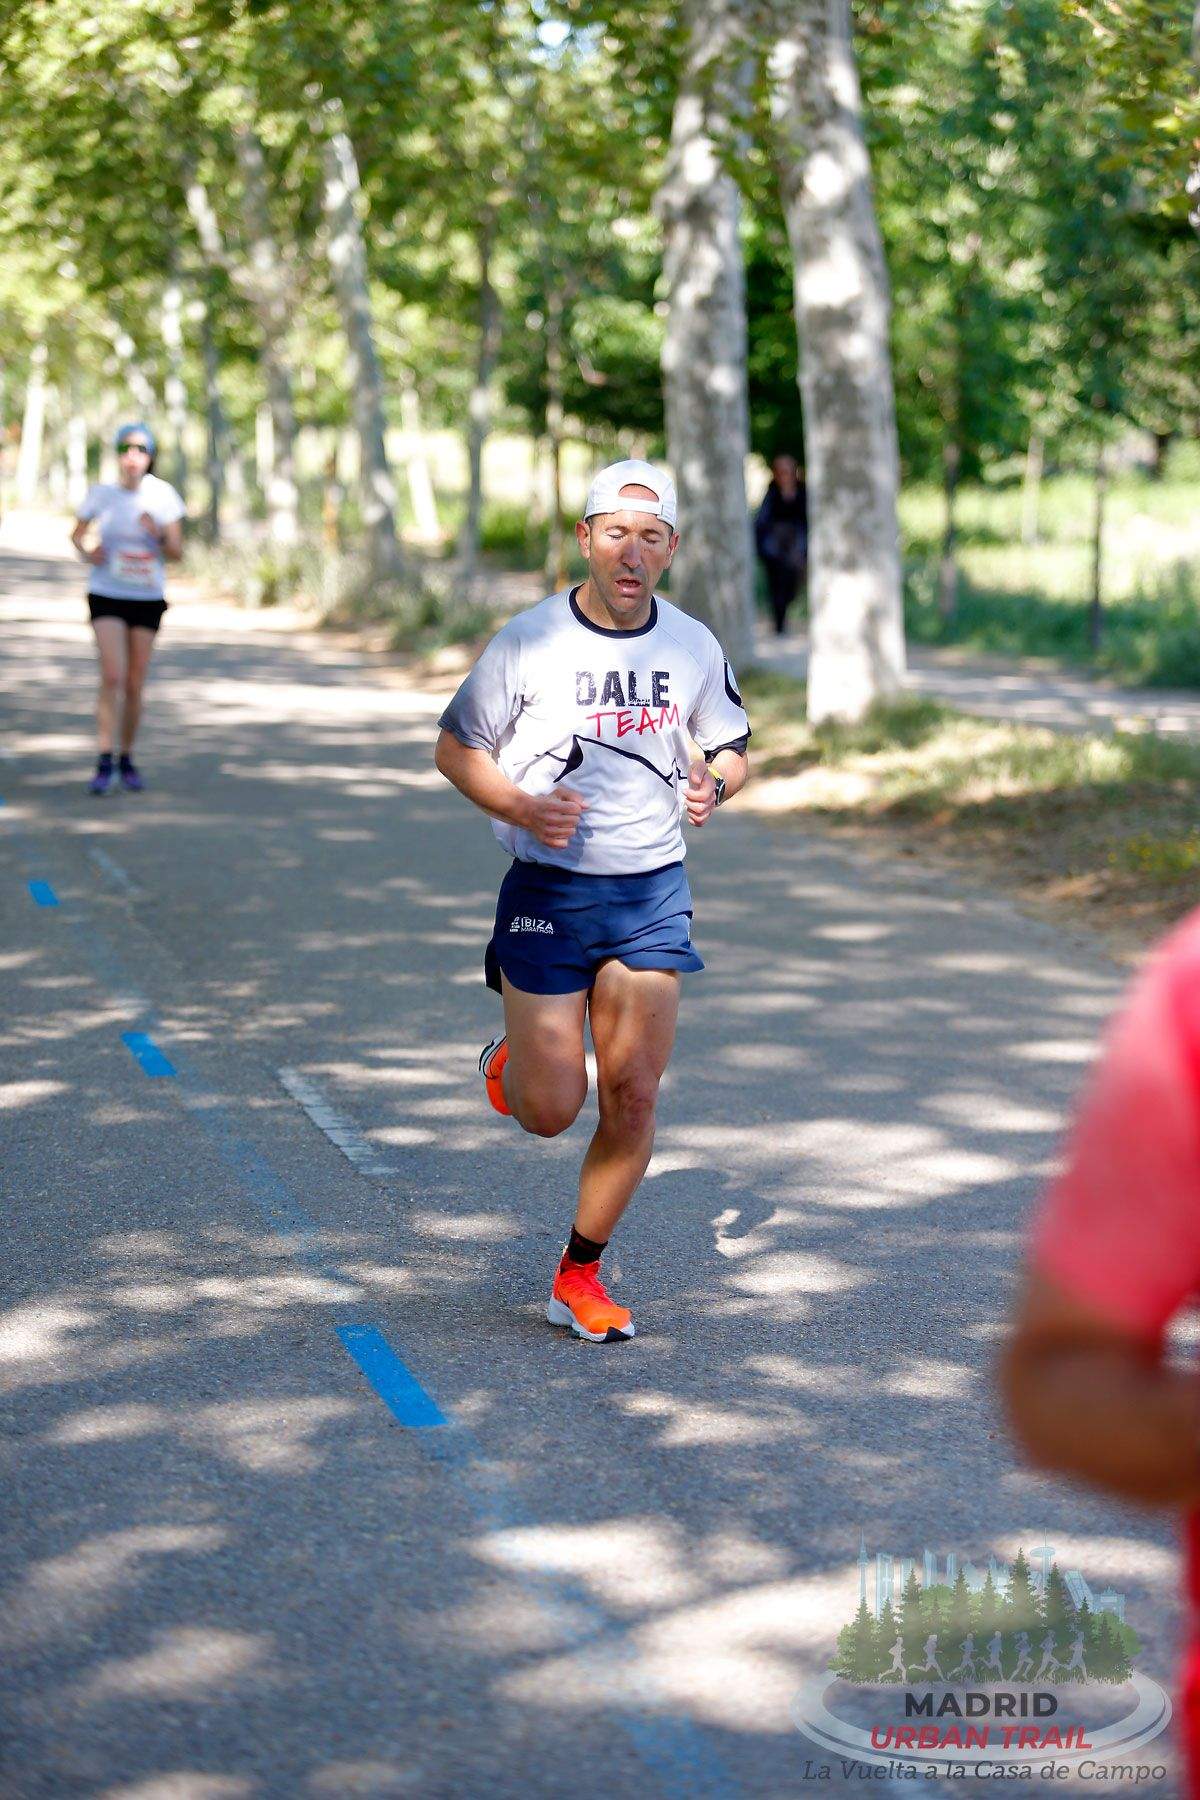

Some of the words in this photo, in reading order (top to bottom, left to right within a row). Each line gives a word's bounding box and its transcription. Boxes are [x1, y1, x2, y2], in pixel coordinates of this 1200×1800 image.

[575, 670, 670, 708] DALE
[585, 703, 680, 738] TEAM
[520, 917, 553, 931] IBIZA
[520, 926, 554, 935] MARATHON
